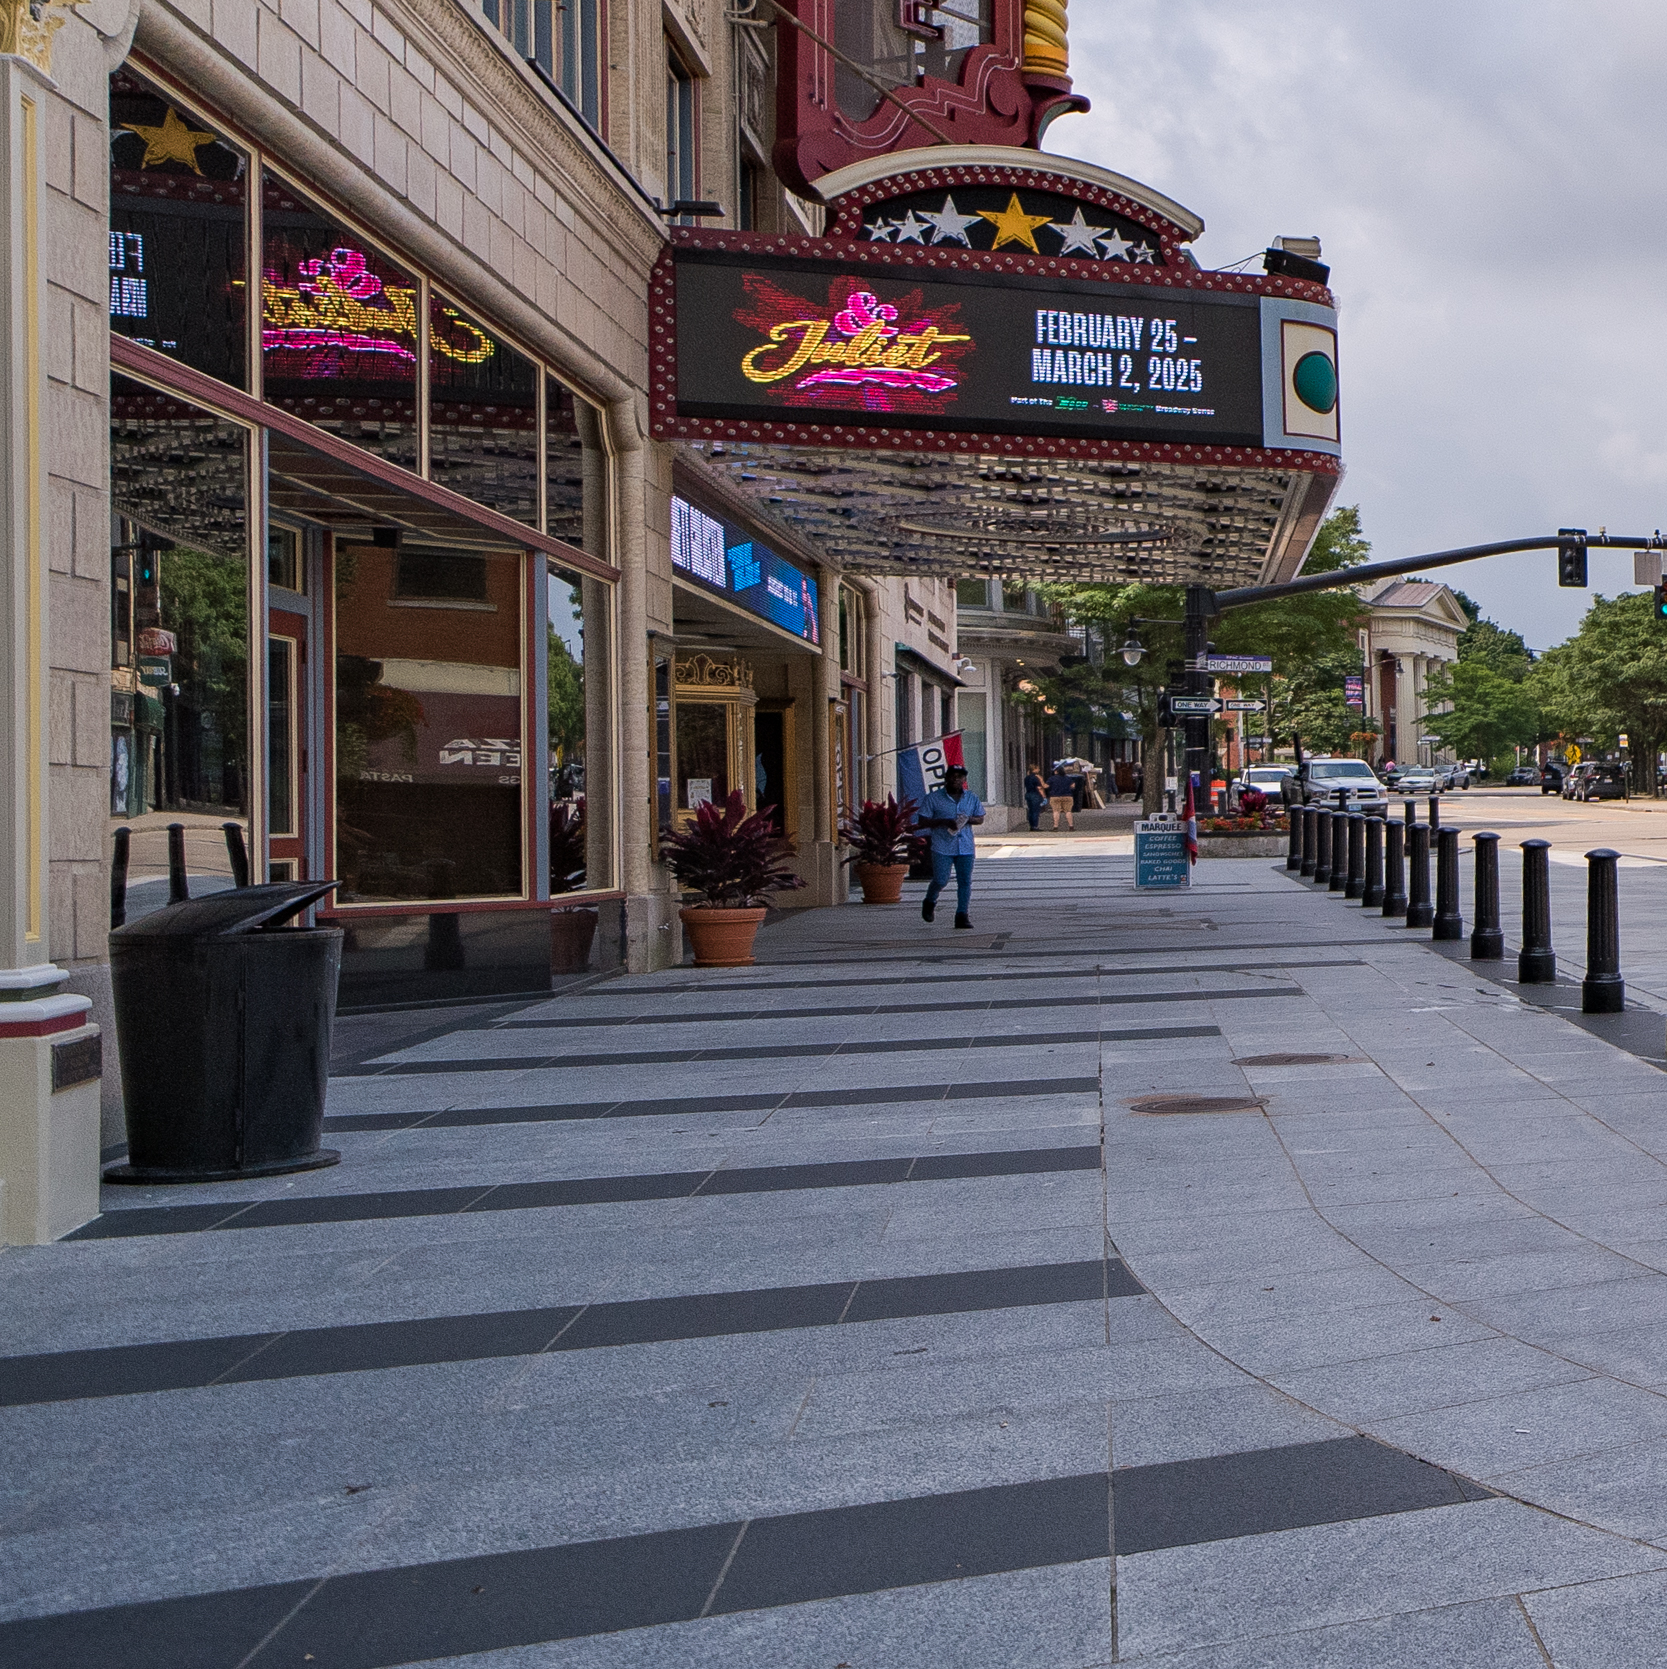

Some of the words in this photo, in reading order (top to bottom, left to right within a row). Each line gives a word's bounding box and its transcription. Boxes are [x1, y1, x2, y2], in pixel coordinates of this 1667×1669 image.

[834, 292, 899, 337] &
[1036, 309, 1144, 350] FEBRUARY
[1150, 318, 1178, 353] 25
[741, 319, 971, 383] Juliet
[1032, 348, 1113, 386] MARCH
[1119, 354, 1141, 394] 2,
[1148, 357, 1203, 392] 2025
[1209, 660, 1262, 671] RICHMOND
[922, 748, 947, 793] OPE
[1141, 823, 1182, 832] MARQUEE
[1148, 873, 1178, 881] LATTE'S
